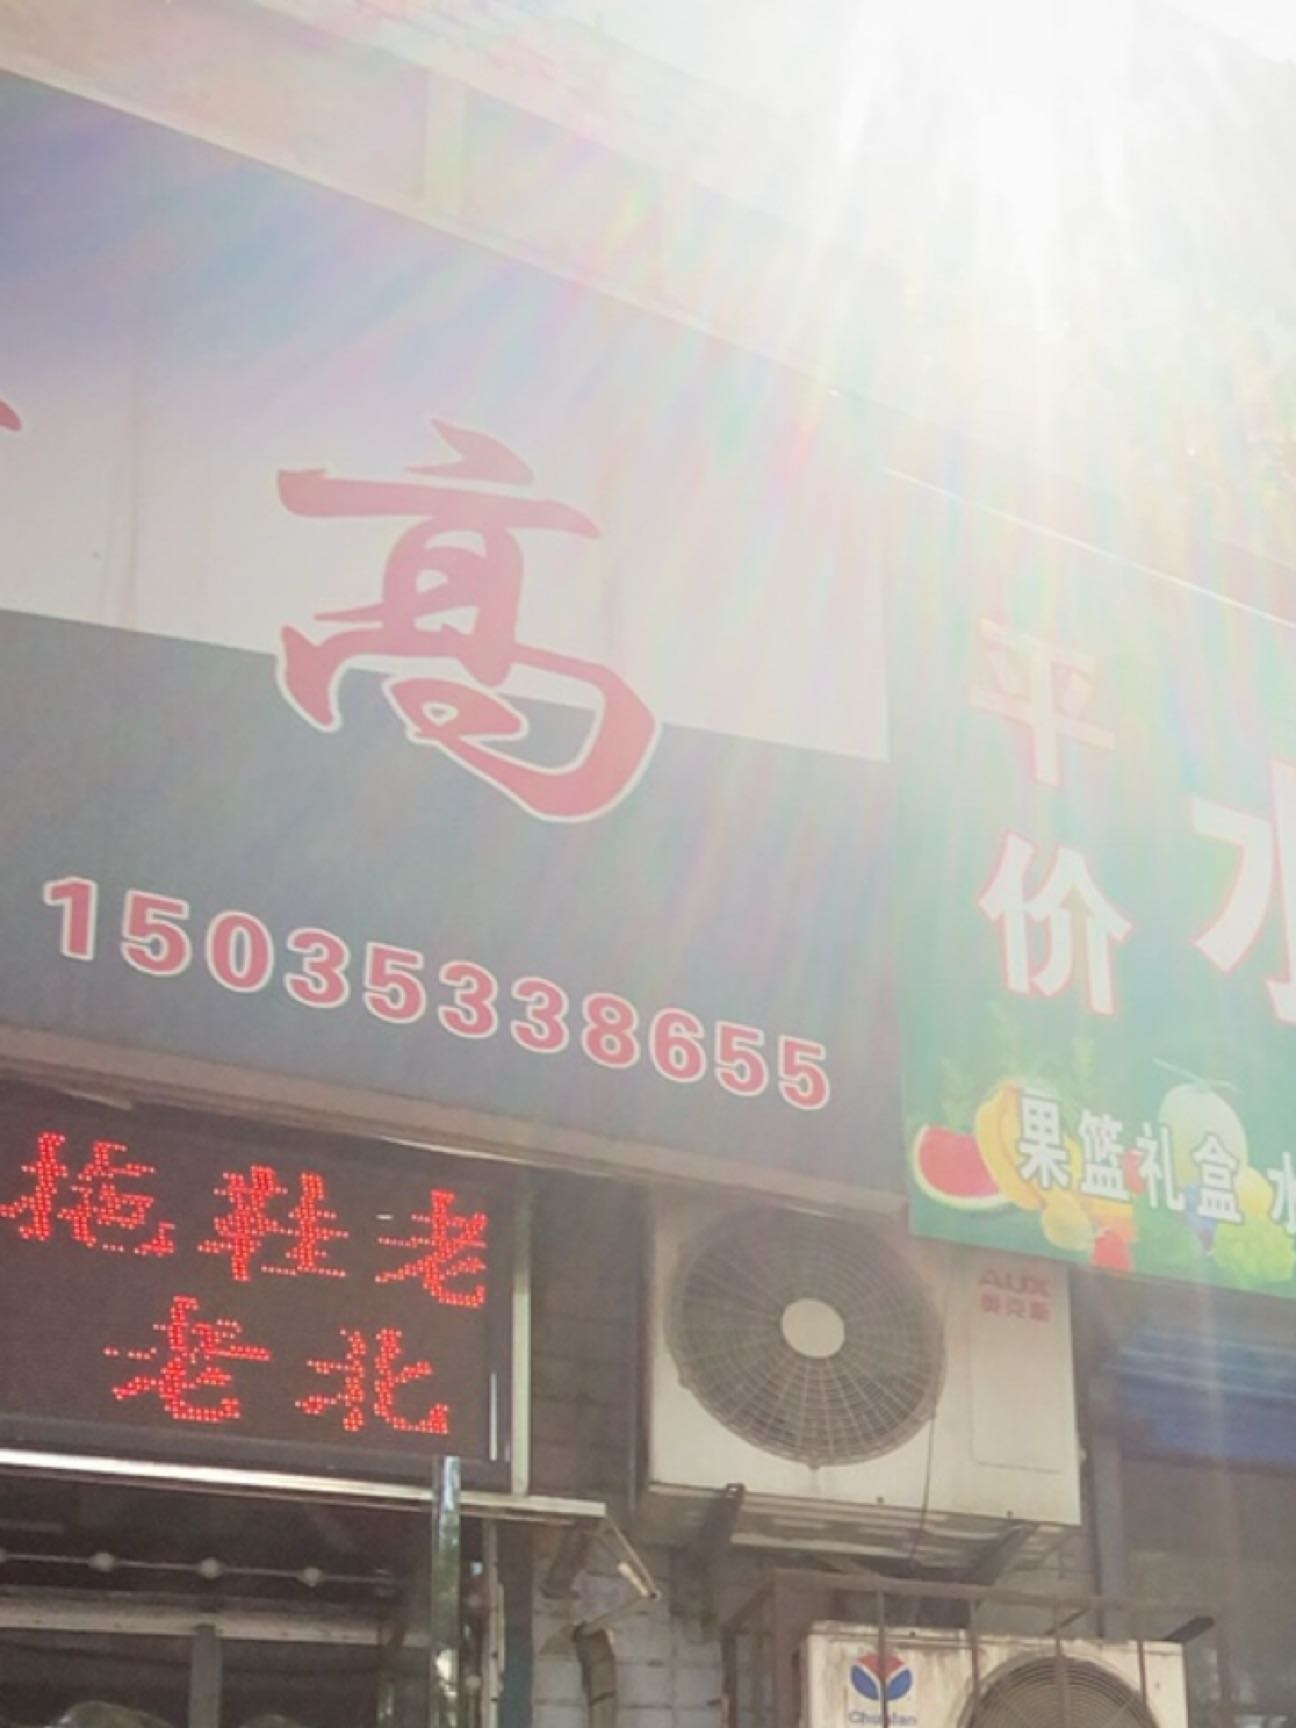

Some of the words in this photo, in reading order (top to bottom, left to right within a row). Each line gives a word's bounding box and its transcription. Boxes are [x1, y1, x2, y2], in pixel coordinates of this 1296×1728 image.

[277, 418, 660, 822] 高
[970, 616, 1134, 1016] 平价
[42, 877, 832, 1110] 15035338655
[1017, 1086, 1245, 1225] 果篮礼盒
[104, 1295, 449, 1434] 老北
